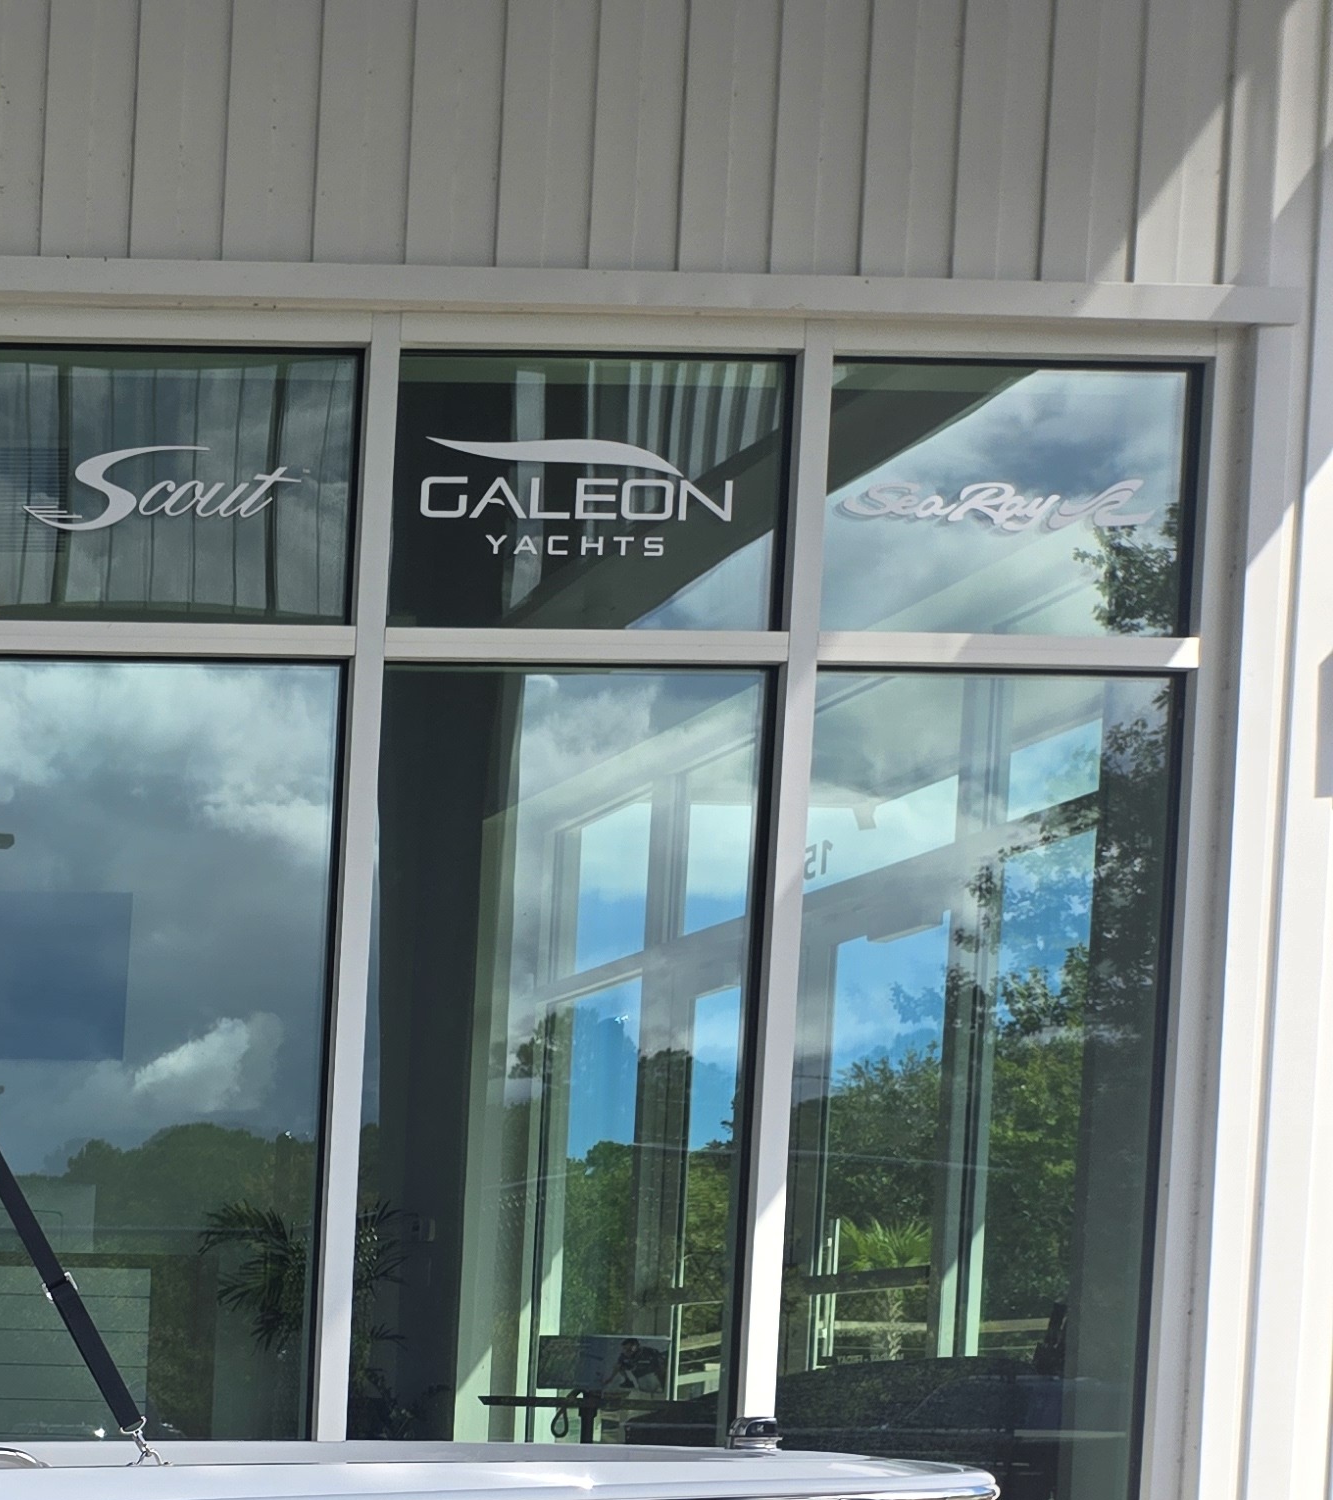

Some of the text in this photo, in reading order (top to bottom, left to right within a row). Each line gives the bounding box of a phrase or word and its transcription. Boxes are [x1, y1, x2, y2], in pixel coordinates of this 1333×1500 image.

[23, 445, 303, 531] Scout
[419, 476, 734, 523] GALEON
[841, 482, 1061, 532] Sea Ray
[485, 534, 665, 557] YACHTS
